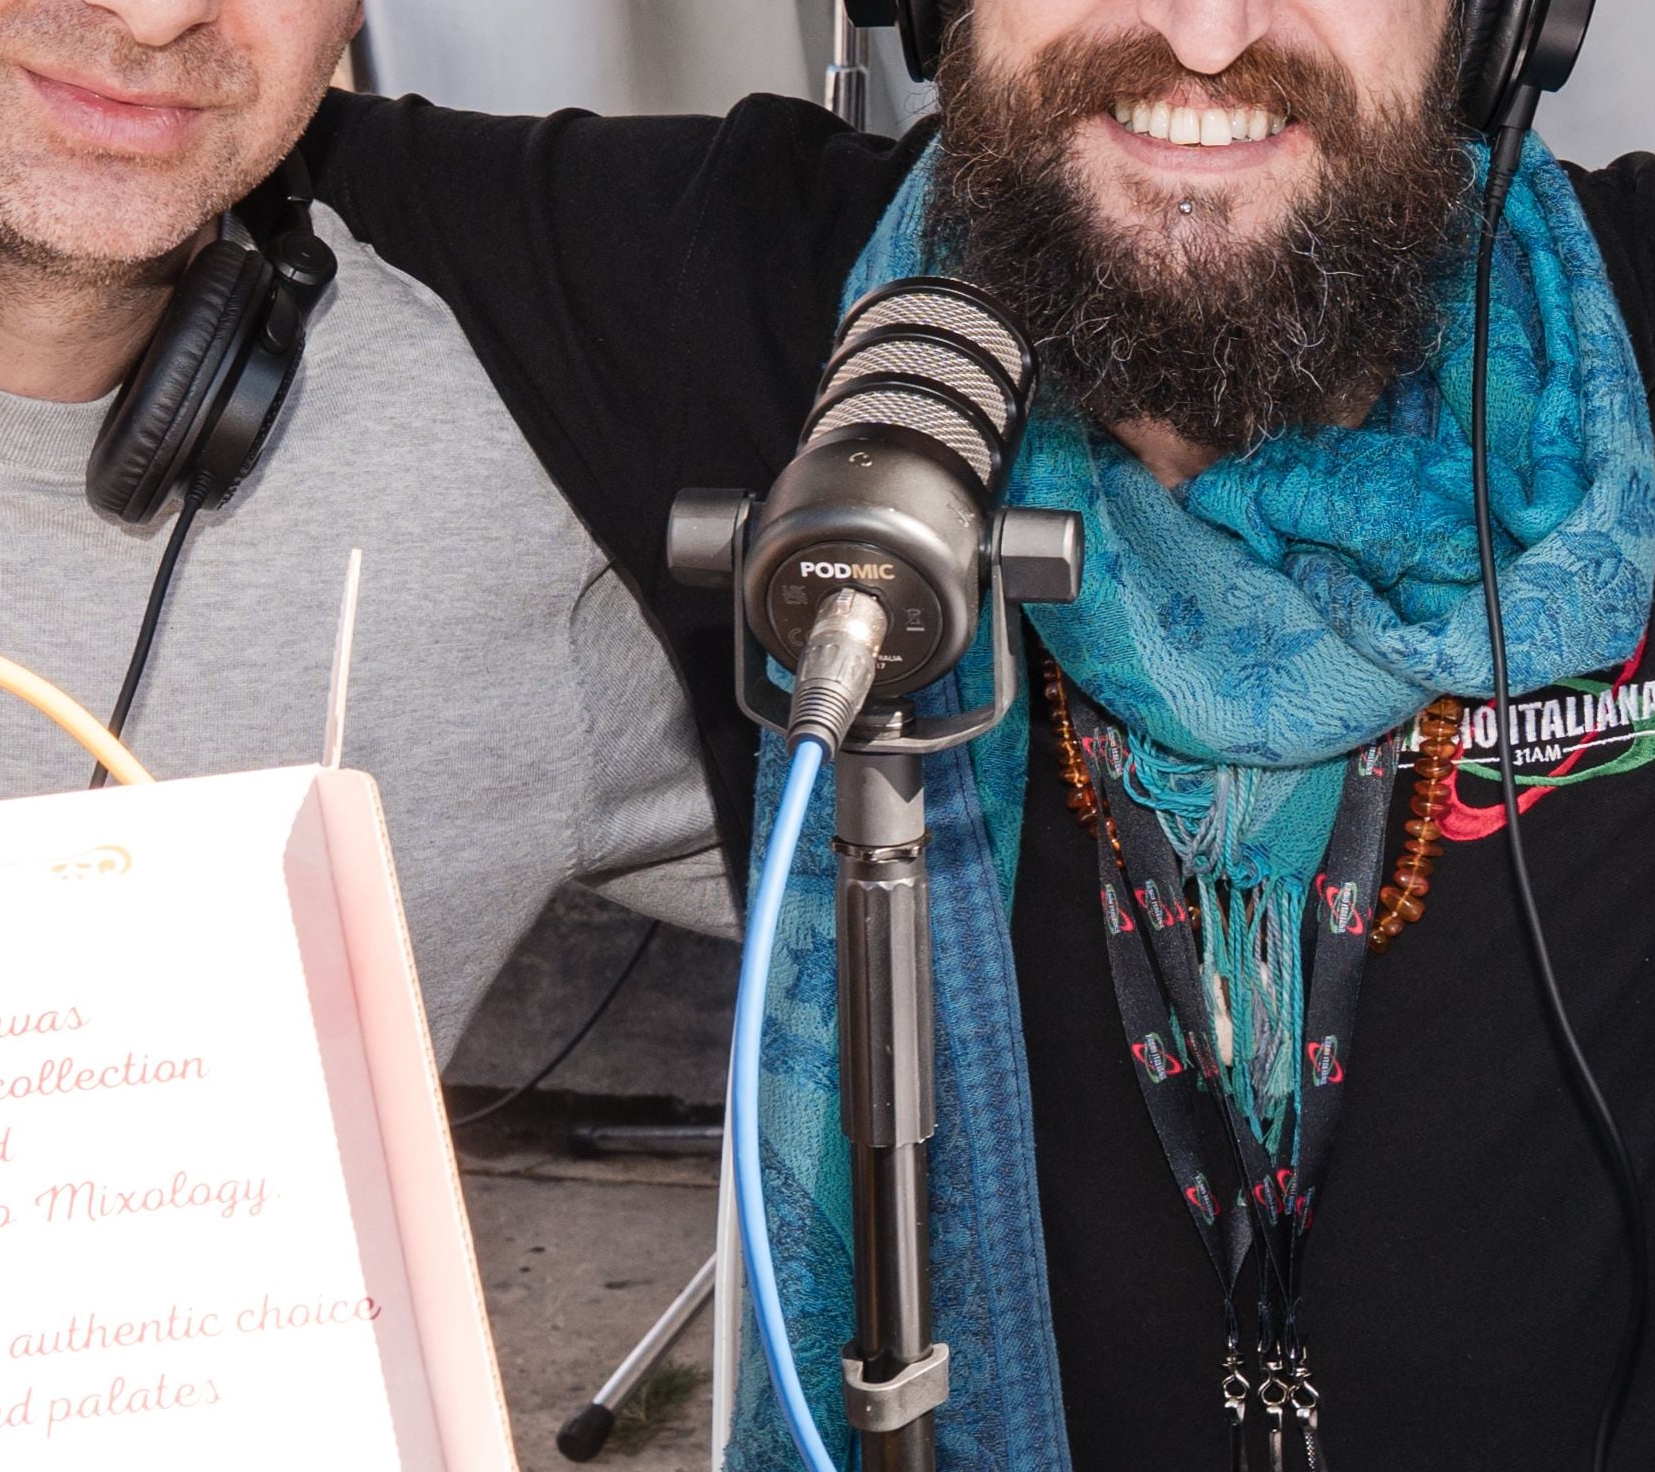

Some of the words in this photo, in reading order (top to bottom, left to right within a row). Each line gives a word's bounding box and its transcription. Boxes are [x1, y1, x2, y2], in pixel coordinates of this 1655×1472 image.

[800, 560, 895, 581] PODMIC
[1512, 743, 1563, 766] 31AM
[8, 1303, 224, 1360] authentic
[235, 1290, 383, 1333] choice
[46, 1371, 222, 1441] palates
